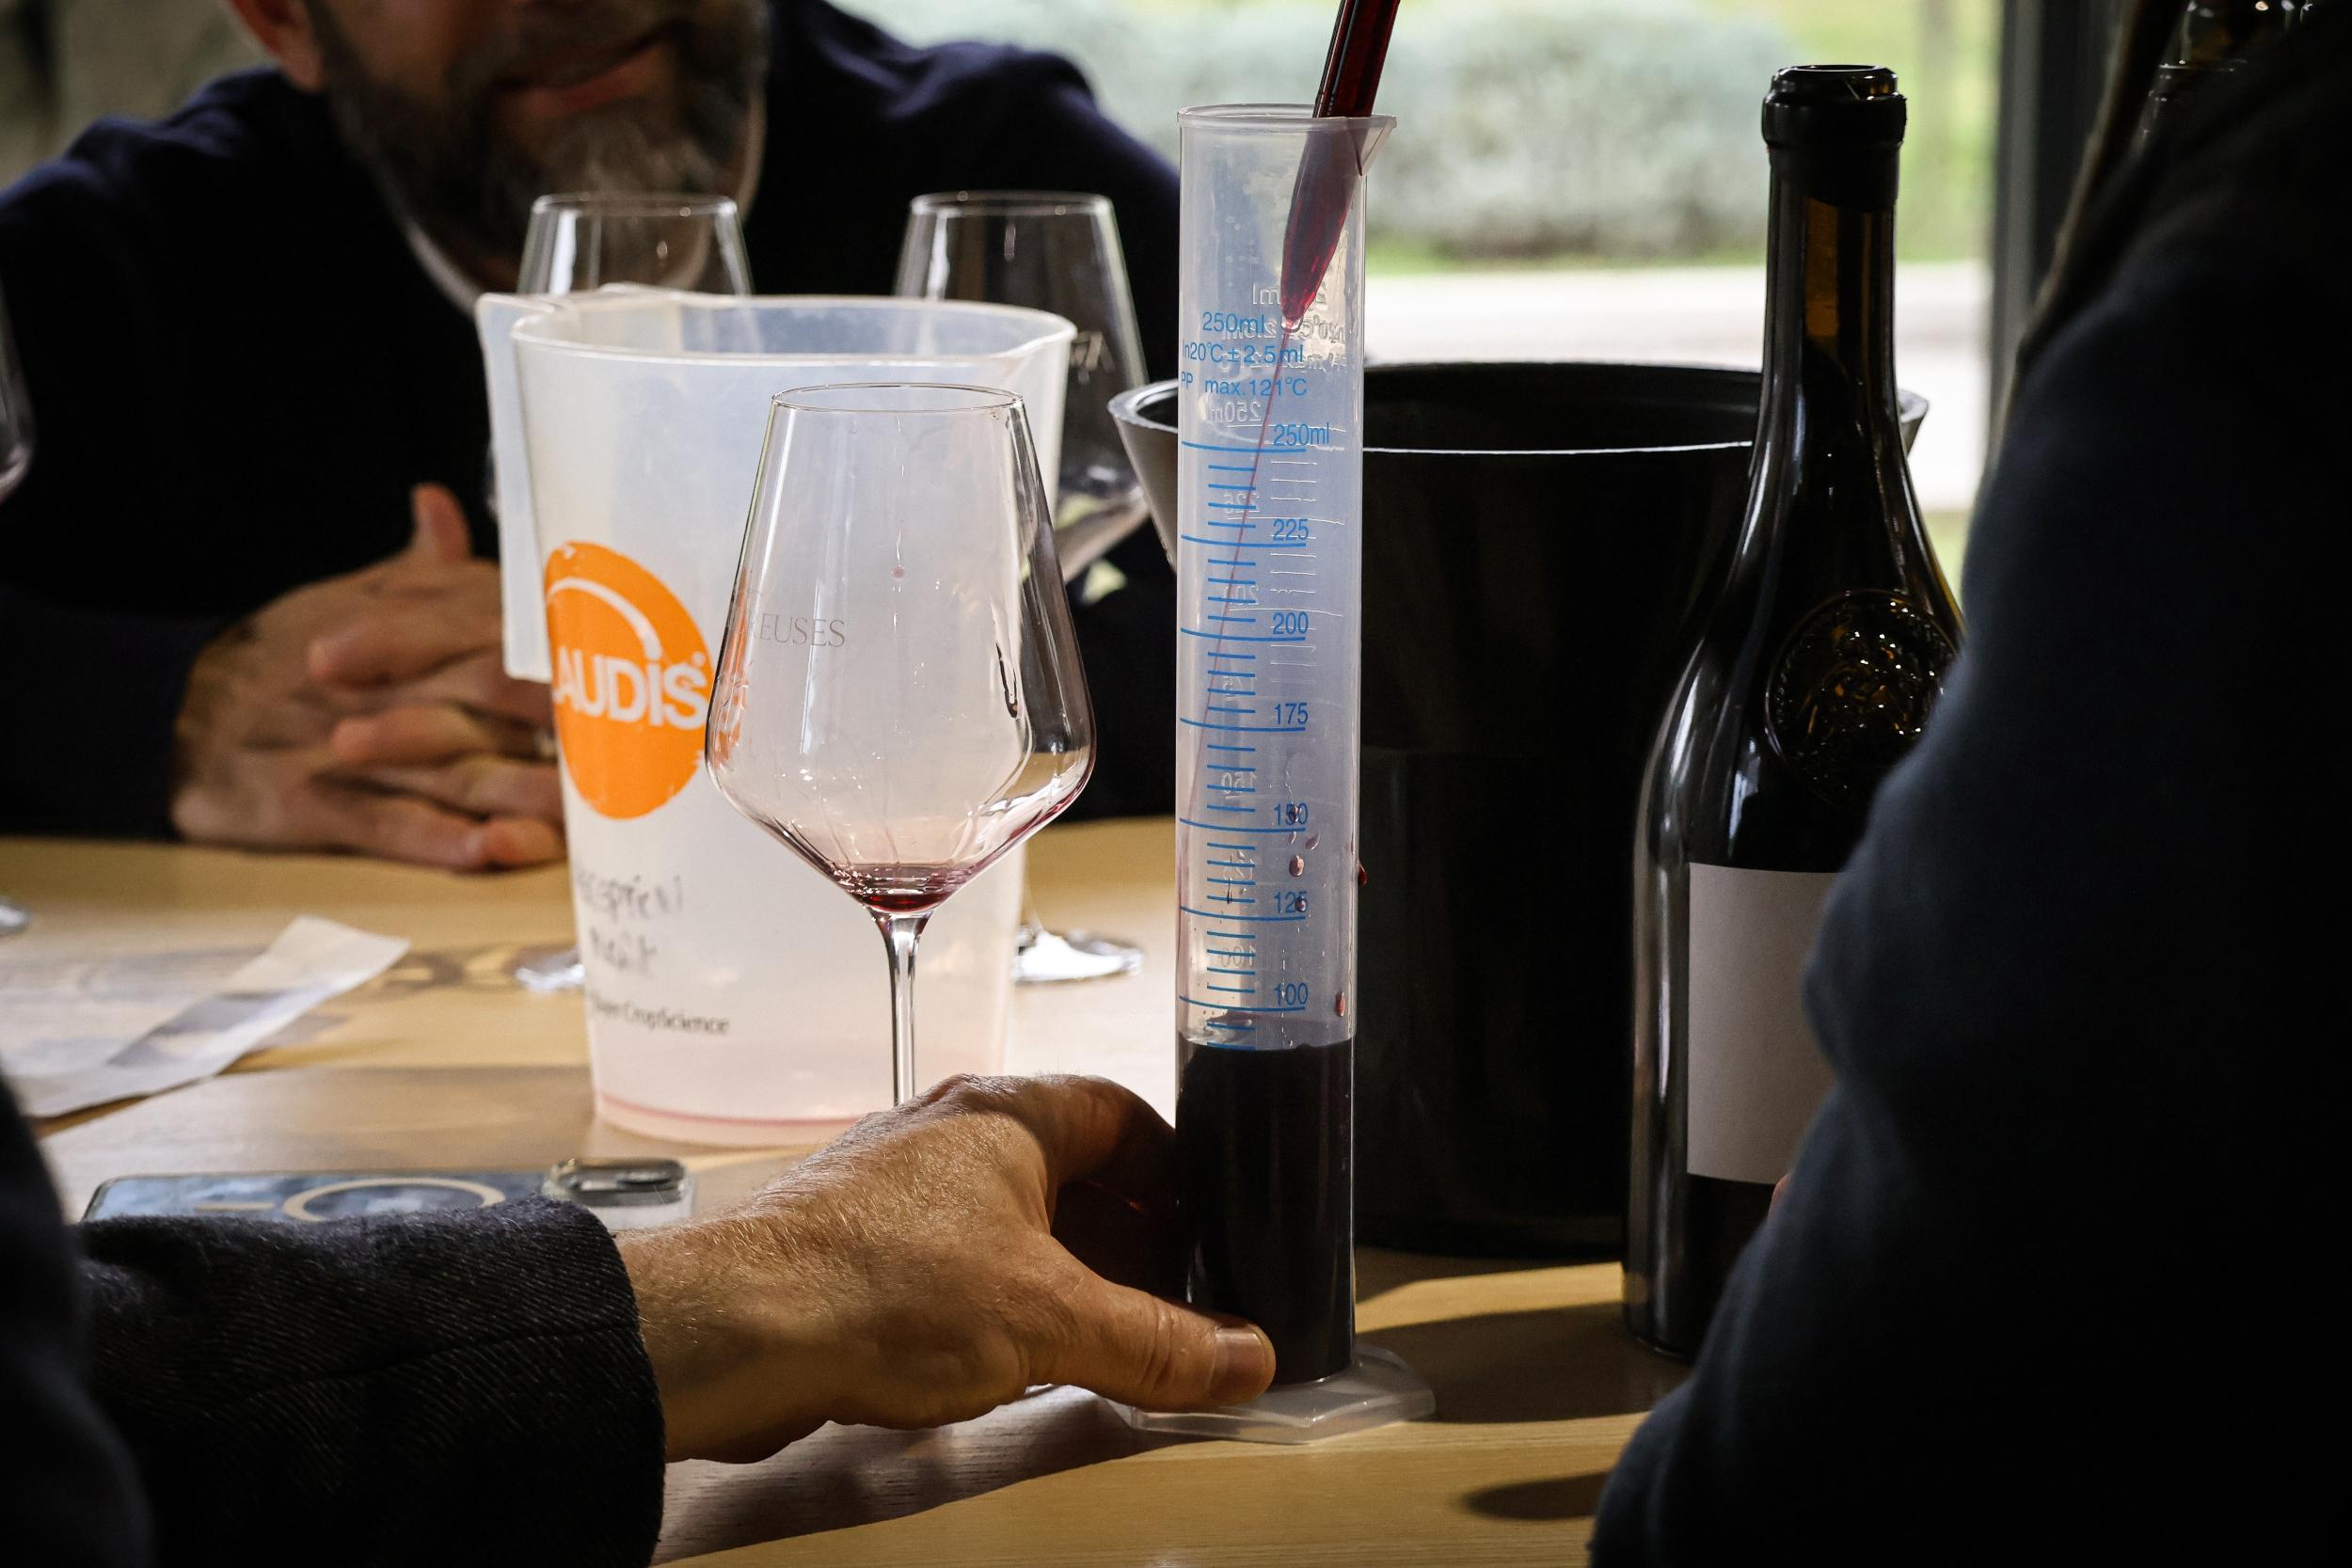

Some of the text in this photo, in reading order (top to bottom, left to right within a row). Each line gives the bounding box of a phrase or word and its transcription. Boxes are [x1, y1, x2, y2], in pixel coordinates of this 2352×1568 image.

[1202, 311, 1265, 333] 250ml
[1273, 422, 1329, 446] 250ml
[1273, 518, 1310, 541] 225
[1272, 611, 1309, 635] 200
[1274, 702, 1309, 725] 175
[1274, 802, 1309, 826] 150
[1274, 890, 1309, 913] 125
[1274, 982, 1309, 1006] 100
